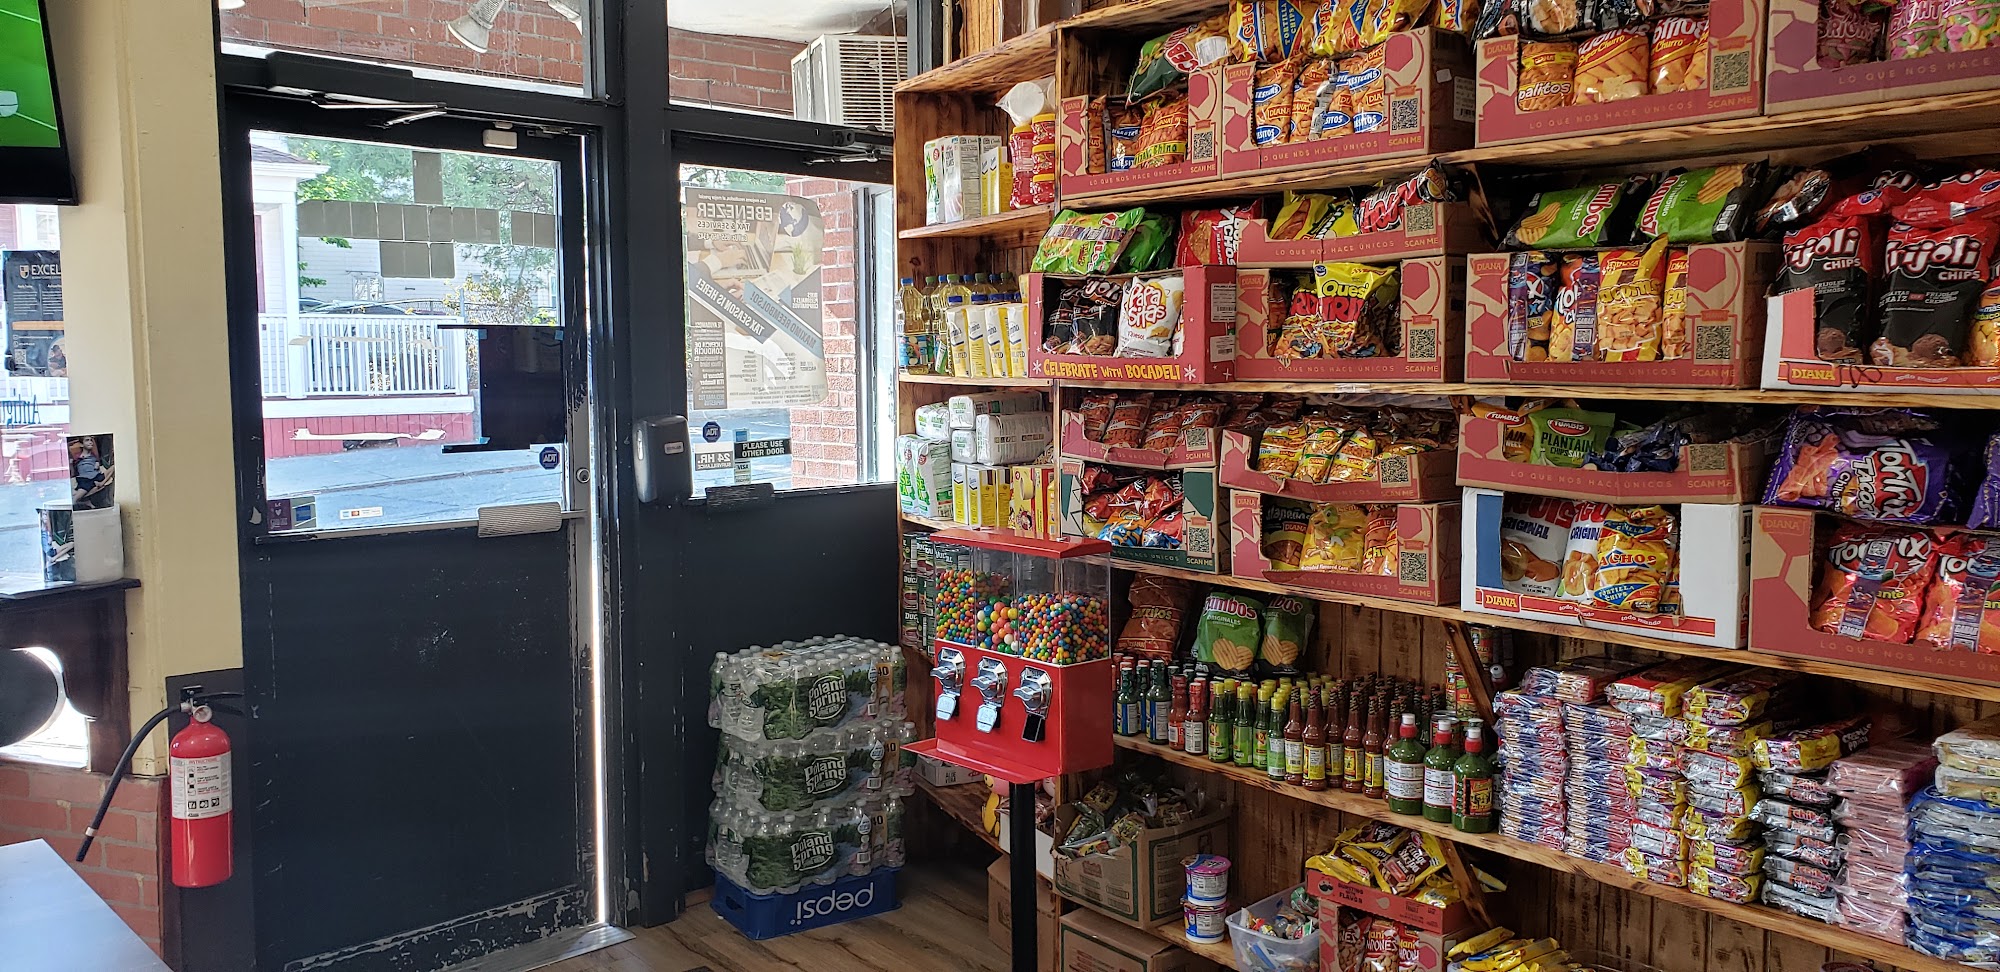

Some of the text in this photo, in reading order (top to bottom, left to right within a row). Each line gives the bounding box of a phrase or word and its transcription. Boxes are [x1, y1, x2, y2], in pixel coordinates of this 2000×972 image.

[1486, 43, 1512, 55] DIANA
[1228, 68, 1249, 80] DIANA
[1839, 57, 1991, 85] LO QUE NOS HACE
[1518, 81, 1571, 101] palitos
[1707, 96, 1753, 109] SCAN ME
[1269, 106, 1292, 118] DIANA
[1529, 121, 1542, 130] LO
[1549, 116, 1571, 127] QUE
[1577, 113, 1599, 124] NOS
[1605, 108, 1637, 120] HACE
[1388, 135, 1422, 147] SCAN ME
[1272, 152, 1289, 161] QUE
[1293, 149, 1310, 158] NOS
[1314, 145, 1338, 155] HACE
[1190, 163, 1216, 174] SCAN ME
[1404, 237, 1439, 248] SCAN ME
[1289, 248, 1306, 256] QUE
[1331, 245, 1354, 254] HACE
[31, 264, 61, 275] EXCEL
[1476, 262, 1502, 271] DIANA
[1823, 258, 1862, 271] CHIPS
[1938, 270, 1981, 281] CHIPS
[1242, 277, 1263, 287] DIANA
[1043, 359, 1098, 378] CELEBRATE
[1124, 364, 1181, 381] BOCADELI
[1405, 365, 1439, 373] SCAN ME
[1691, 368, 1736, 377] SCAN ME
[1791, 368, 1836, 381] DIANA
[1489, 412, 1521, 423] TUMBIS
[1552, 419, 1585, 431] TUMBIS
[706, 427, 718, 437] ADT
[743, 441, 768, 450] PLEASE
[1541, 431, 1594, 452] PLANTAIN
[543, 453, 558, 463] ADT
[742, 447, 785, 458] OTHER DOOR
[1550, 446, 1586, 459] CHIPS SALT
[1510, 470, 1526, 478] LO
[1530, 472, 1552, 481] QUE
[1558, 475, 1582, 484] NOS
[1687, 480, 1733, 488] SCAN ME
[1380, 489, 1414, 497] SCAN ME
[1237, 498, 1256, 507] DIANA
[1284, 523, 1307, 532] DIANA
[1766, 518, 1800, 530] DIANA
[1570, 526, 1600, 541] ORIGIN
[1600, 551, 1657, 568] ACHOS
[1398, 587, 1432, 598] SCAN ME
[1485, 594, 1517, 608] DIANA
[1207, 615, 1241, 625] ORIGINALES
[1641, 618, 1662, 626] mundo
[1820, 640, 1967, 668] LO QUE NOS HACE
[878, 666, 889, 676] 40
[808, 674, 846, 701] Poland
[809, 690, 847, 719] Spring
[804, 755, 846, 781] Poland
[806, 769, 847, 795] Spring
[790, 831, 834, 859] Poland
[792, 844, 834, 871] Spring
[1407, 841, 1428, 865] Fudge
[794, 882, 874, 925] pepsi
[1339, 892, 1362, 903] FLAVOR
